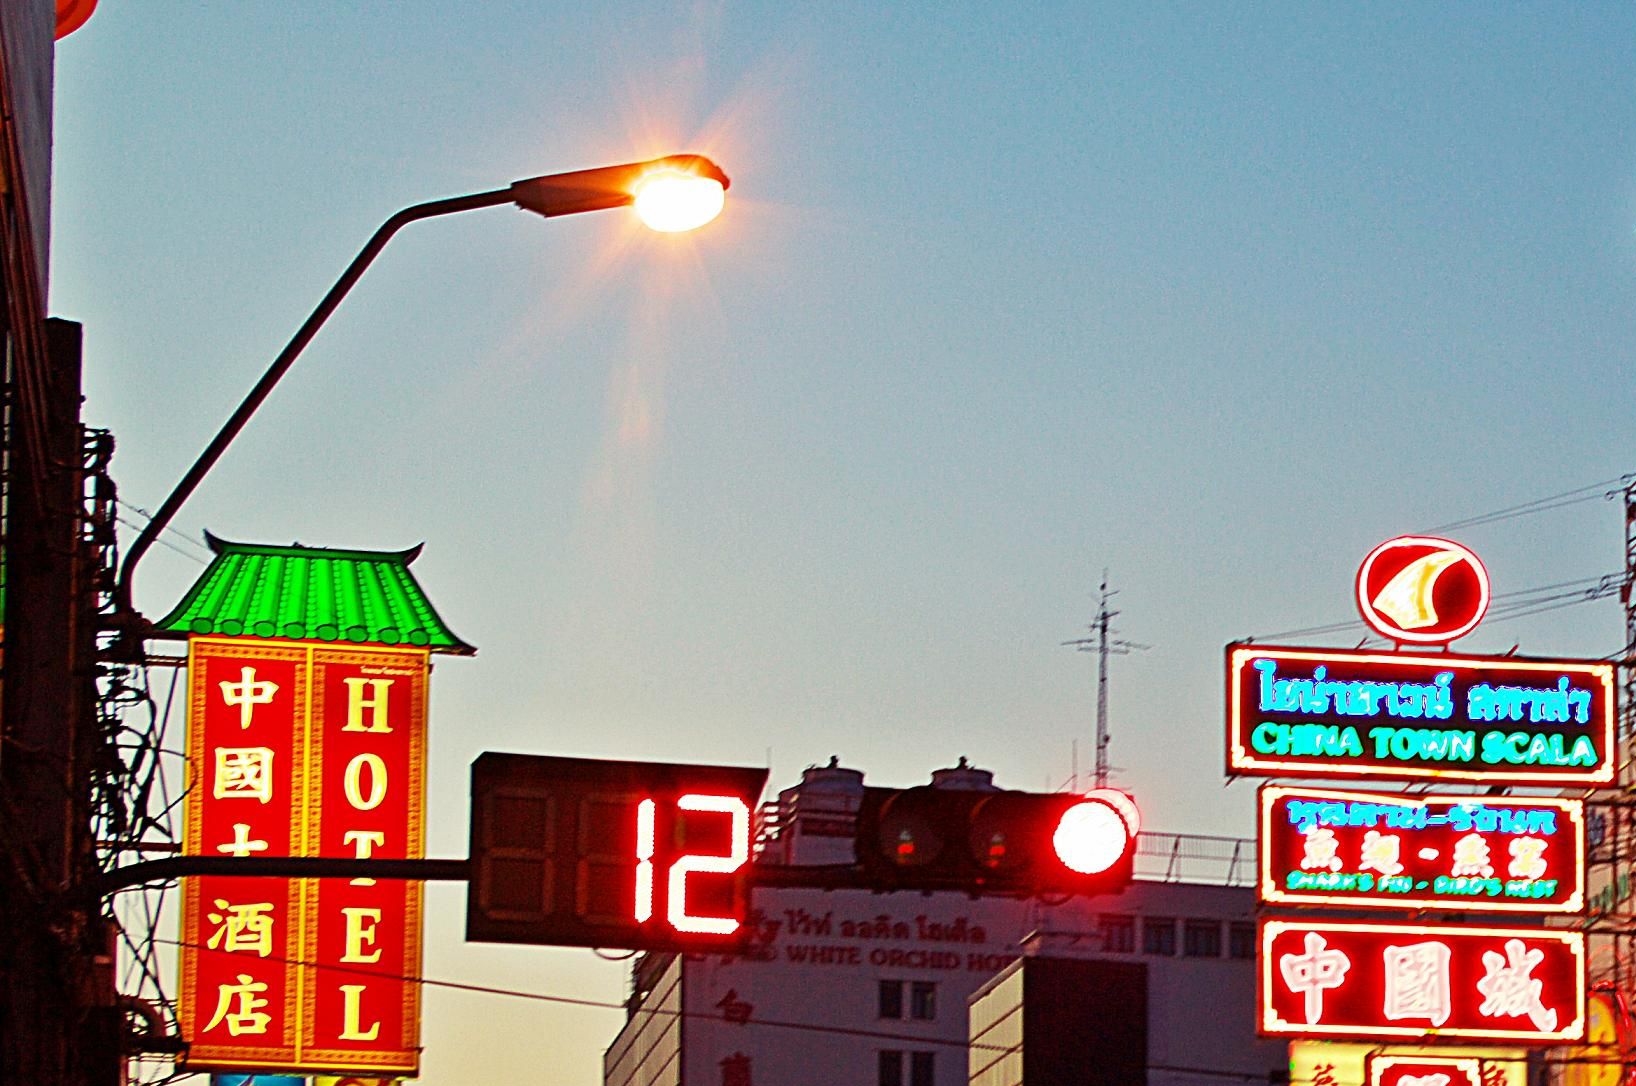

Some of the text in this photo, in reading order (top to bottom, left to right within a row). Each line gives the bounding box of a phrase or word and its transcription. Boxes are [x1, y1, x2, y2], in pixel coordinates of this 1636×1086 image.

[1251, 722, 1598, 767] CHINA TOWN SCALA
[339, 676, 395, 1041] HOTEL
[634, 793, 750, 934] 12
[787, 946, 863, 965] WHITE
[868, 950, 961, 971] ORCHID
